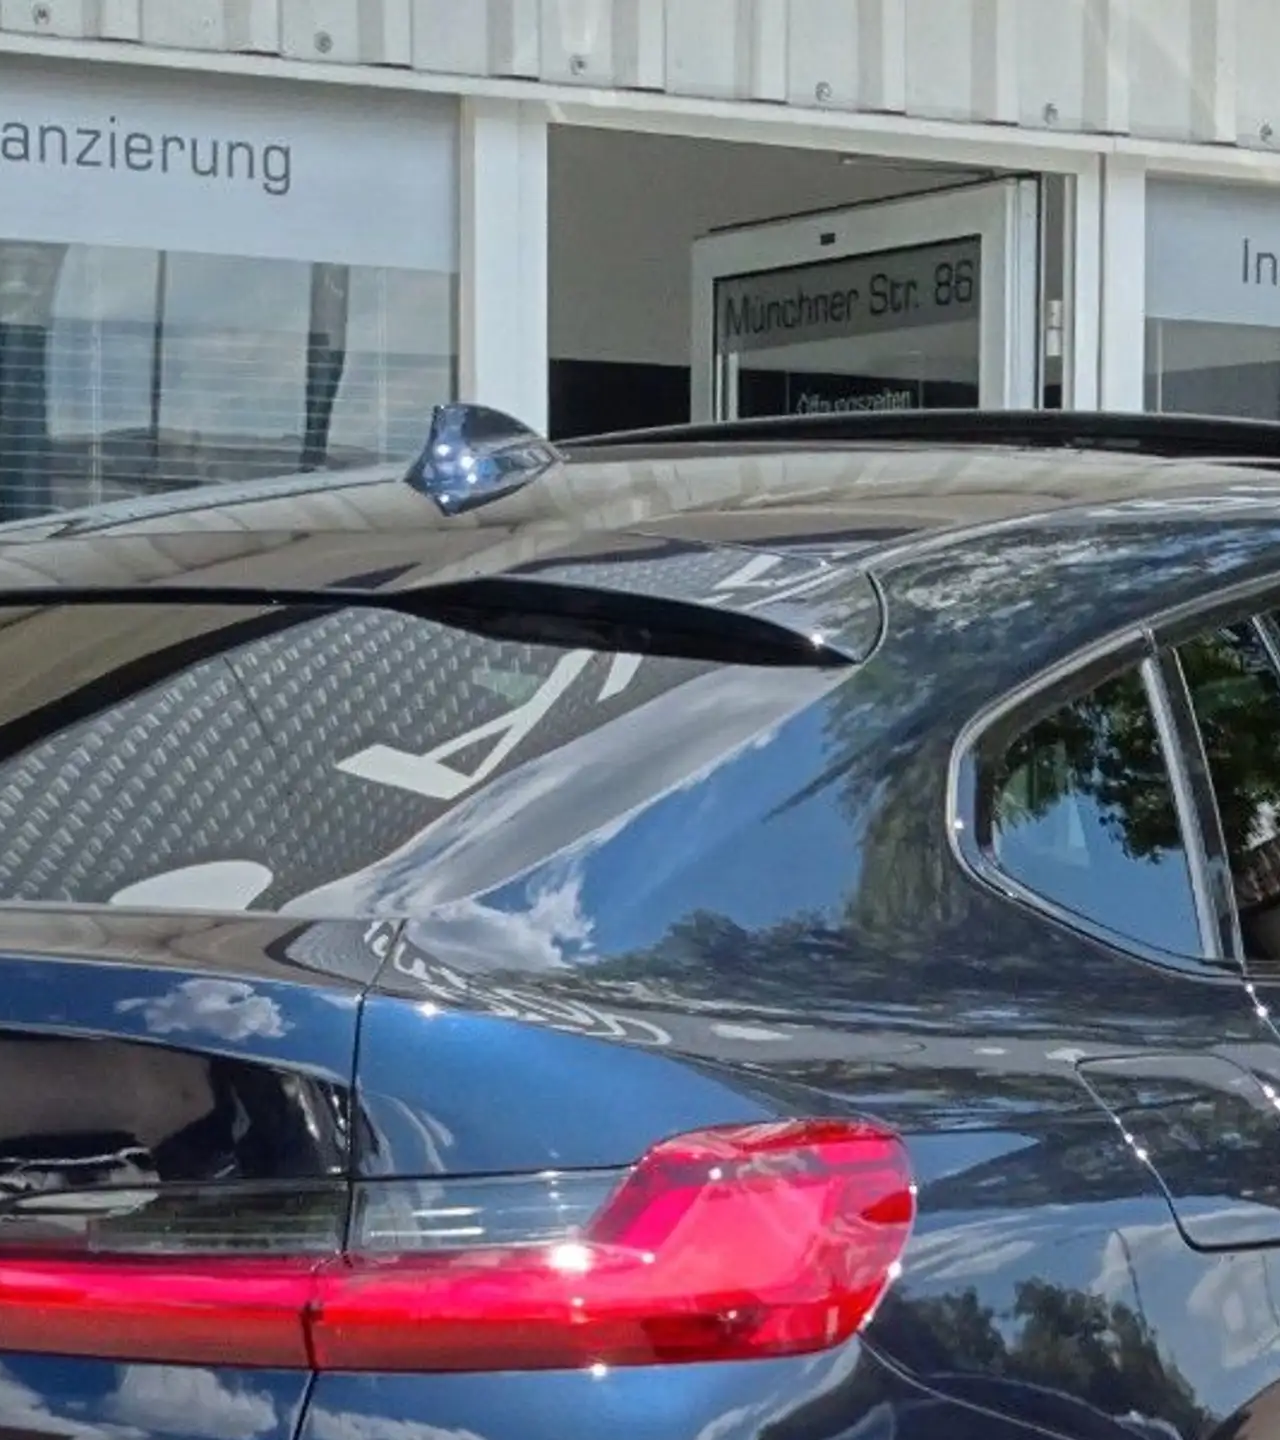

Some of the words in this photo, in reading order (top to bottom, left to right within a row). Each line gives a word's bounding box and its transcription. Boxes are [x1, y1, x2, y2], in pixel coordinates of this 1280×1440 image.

[723, 284, 859, 338] Münchner
[869, 273, 920, 317] Str.
[933, 258, 975, 307] 86
